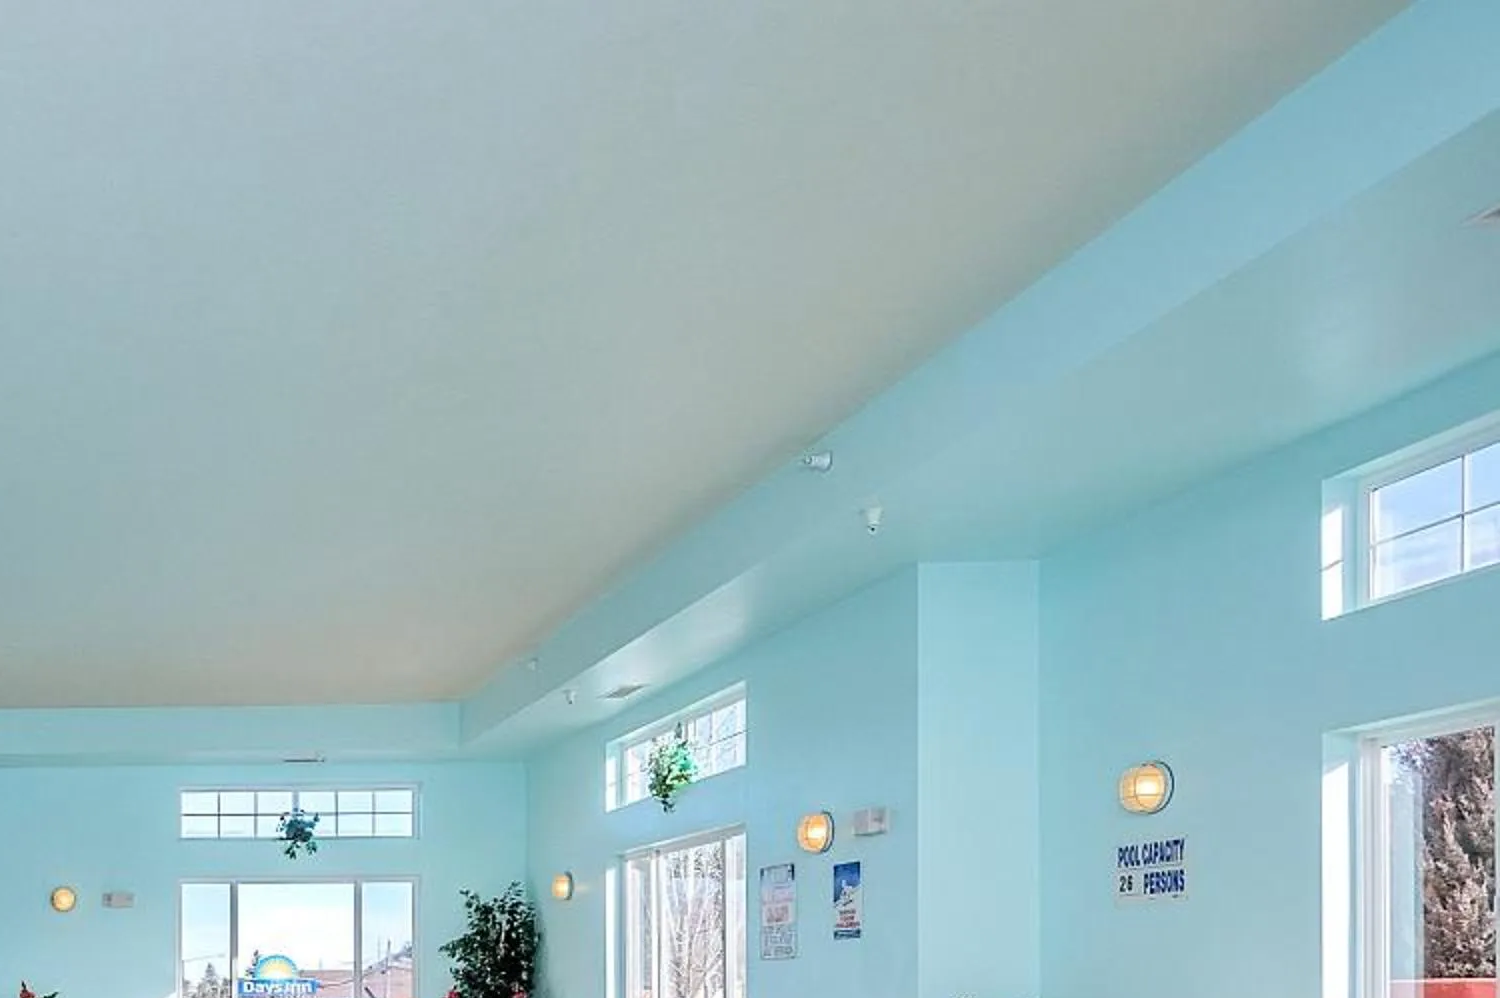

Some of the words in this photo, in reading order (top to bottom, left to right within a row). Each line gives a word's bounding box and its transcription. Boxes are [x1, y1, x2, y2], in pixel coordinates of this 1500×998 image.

[1117, 845, 1141, 868] POOL
[1142, 838, 1185, 864] CAPACITY
[1143, 869, 1184, 894] PERSONS
[243, 981, 284, 997] Days
[285, 981, 312, 994] Inn
